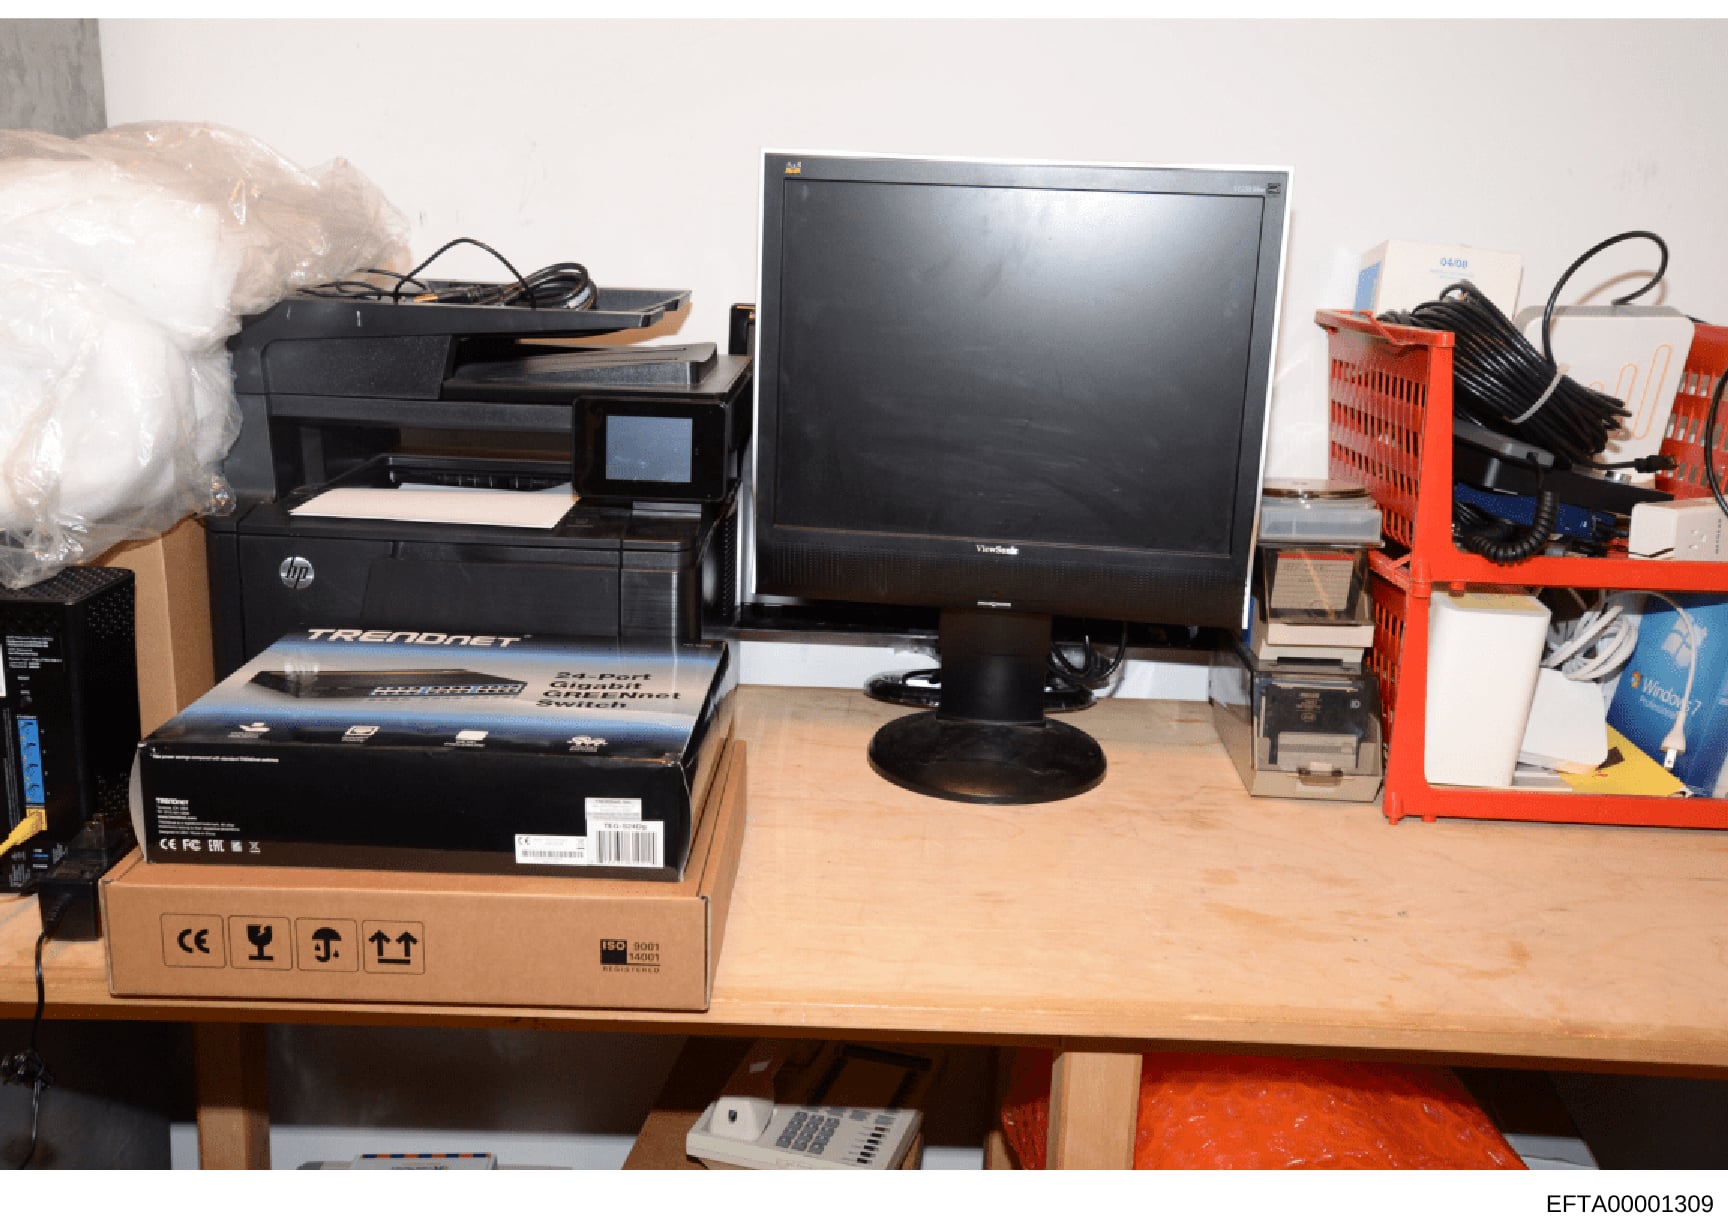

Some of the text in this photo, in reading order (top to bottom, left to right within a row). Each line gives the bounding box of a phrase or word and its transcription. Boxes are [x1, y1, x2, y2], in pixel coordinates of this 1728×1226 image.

[554, 671, 653, 681] 24-Port
[549, 680, 643, 690] Gigabit
[542, 690, 681, 700] GREENnet
[536, 699, 627, 708] Switch
[177, 928, 210, 954] CE
[602, 941, 660, 951] ISO 9001
[629, 952, 660, 961] 14001
